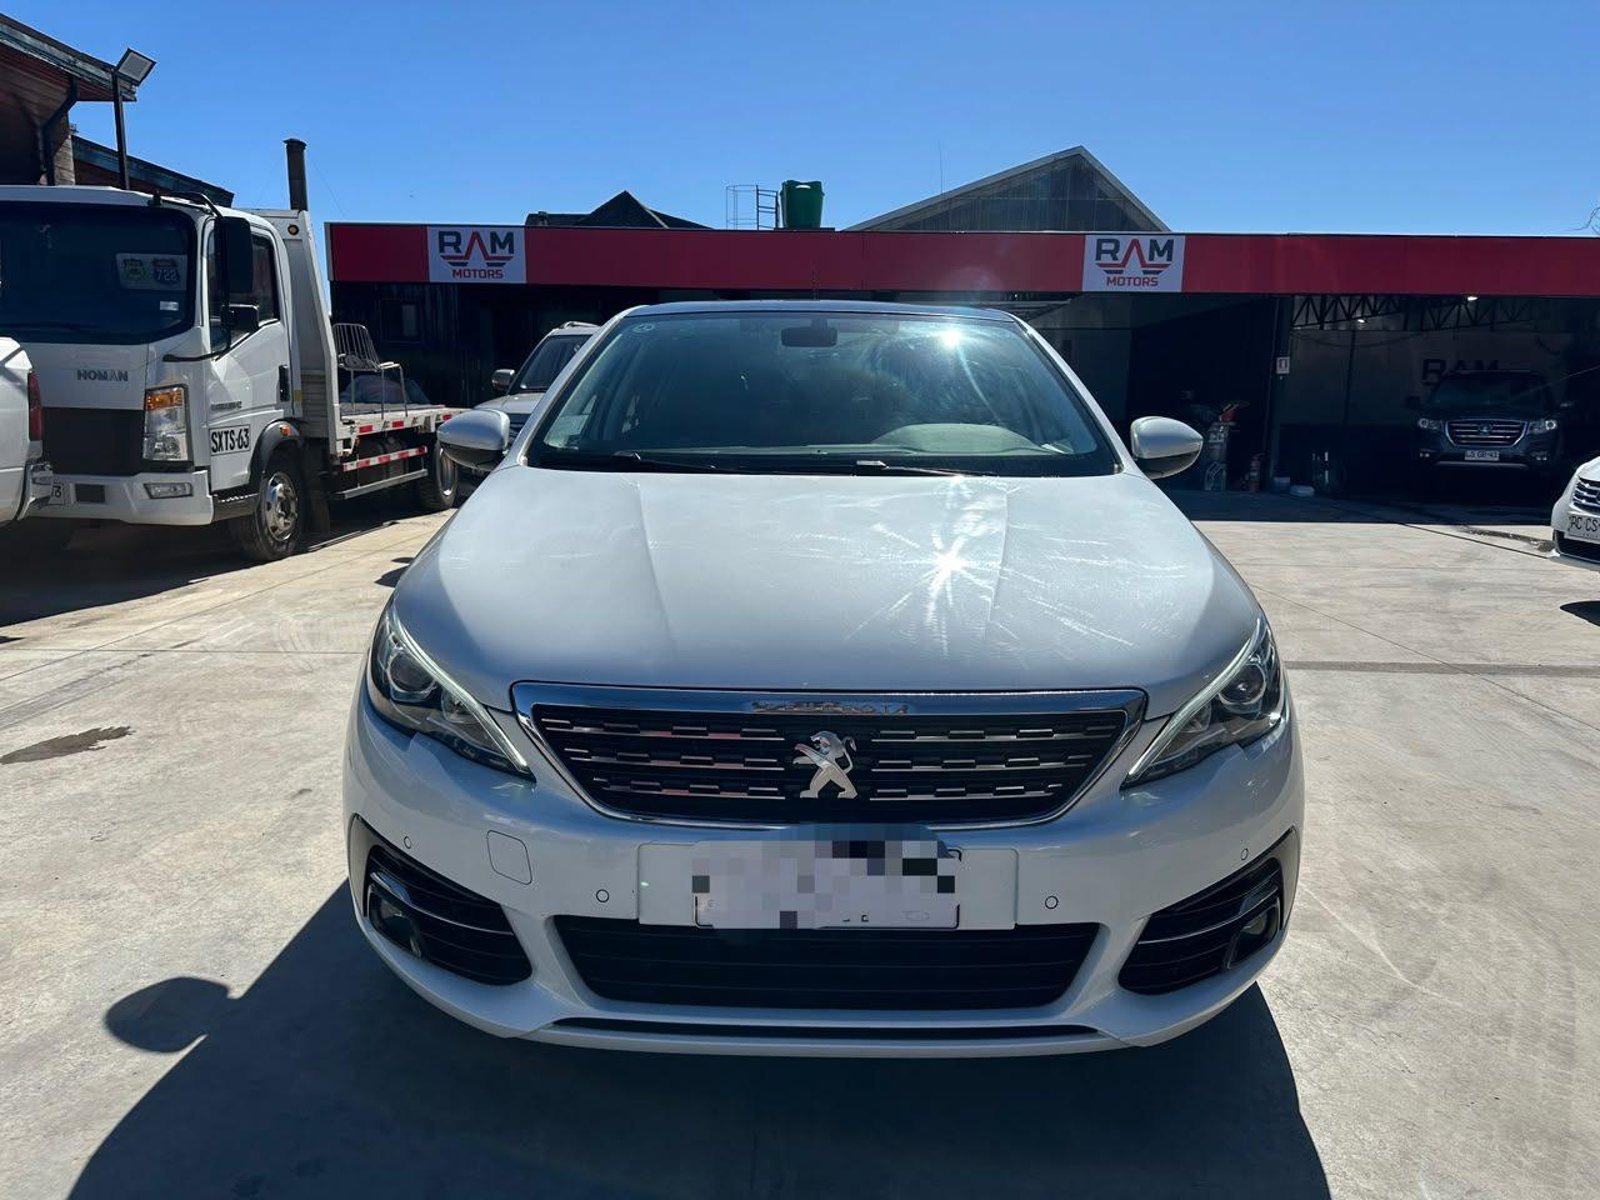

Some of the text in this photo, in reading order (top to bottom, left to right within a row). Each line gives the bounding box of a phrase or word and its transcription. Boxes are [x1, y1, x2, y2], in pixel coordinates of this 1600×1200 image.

[438, 231, 514, 259] RAM
[1096, 238, 1174, 265] RAM
[452, 269, 504, 279] MOTORS
[1106, 276, 1159, 287] MOTORS
[211, 428, 250, 453] SXTS-63
